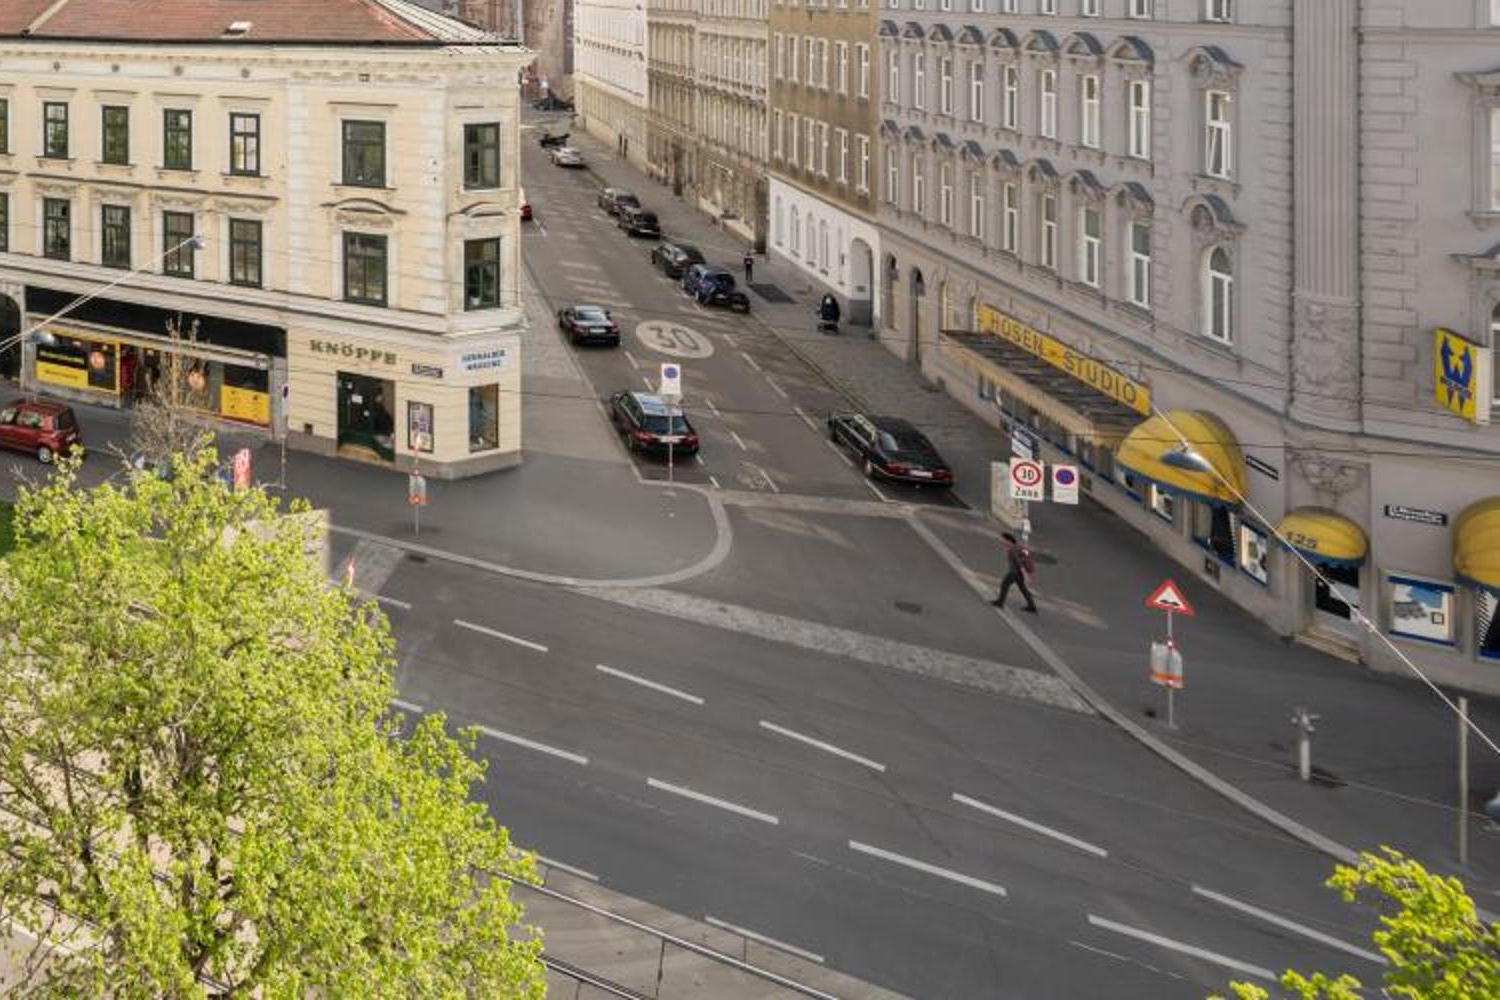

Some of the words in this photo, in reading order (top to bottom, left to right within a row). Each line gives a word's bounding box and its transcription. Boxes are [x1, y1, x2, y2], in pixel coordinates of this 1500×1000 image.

[647, 326, 700, 351] 30
[1063, 350, 1137, 402] STUDIO
[1020, 467, 1035, 481] 30
